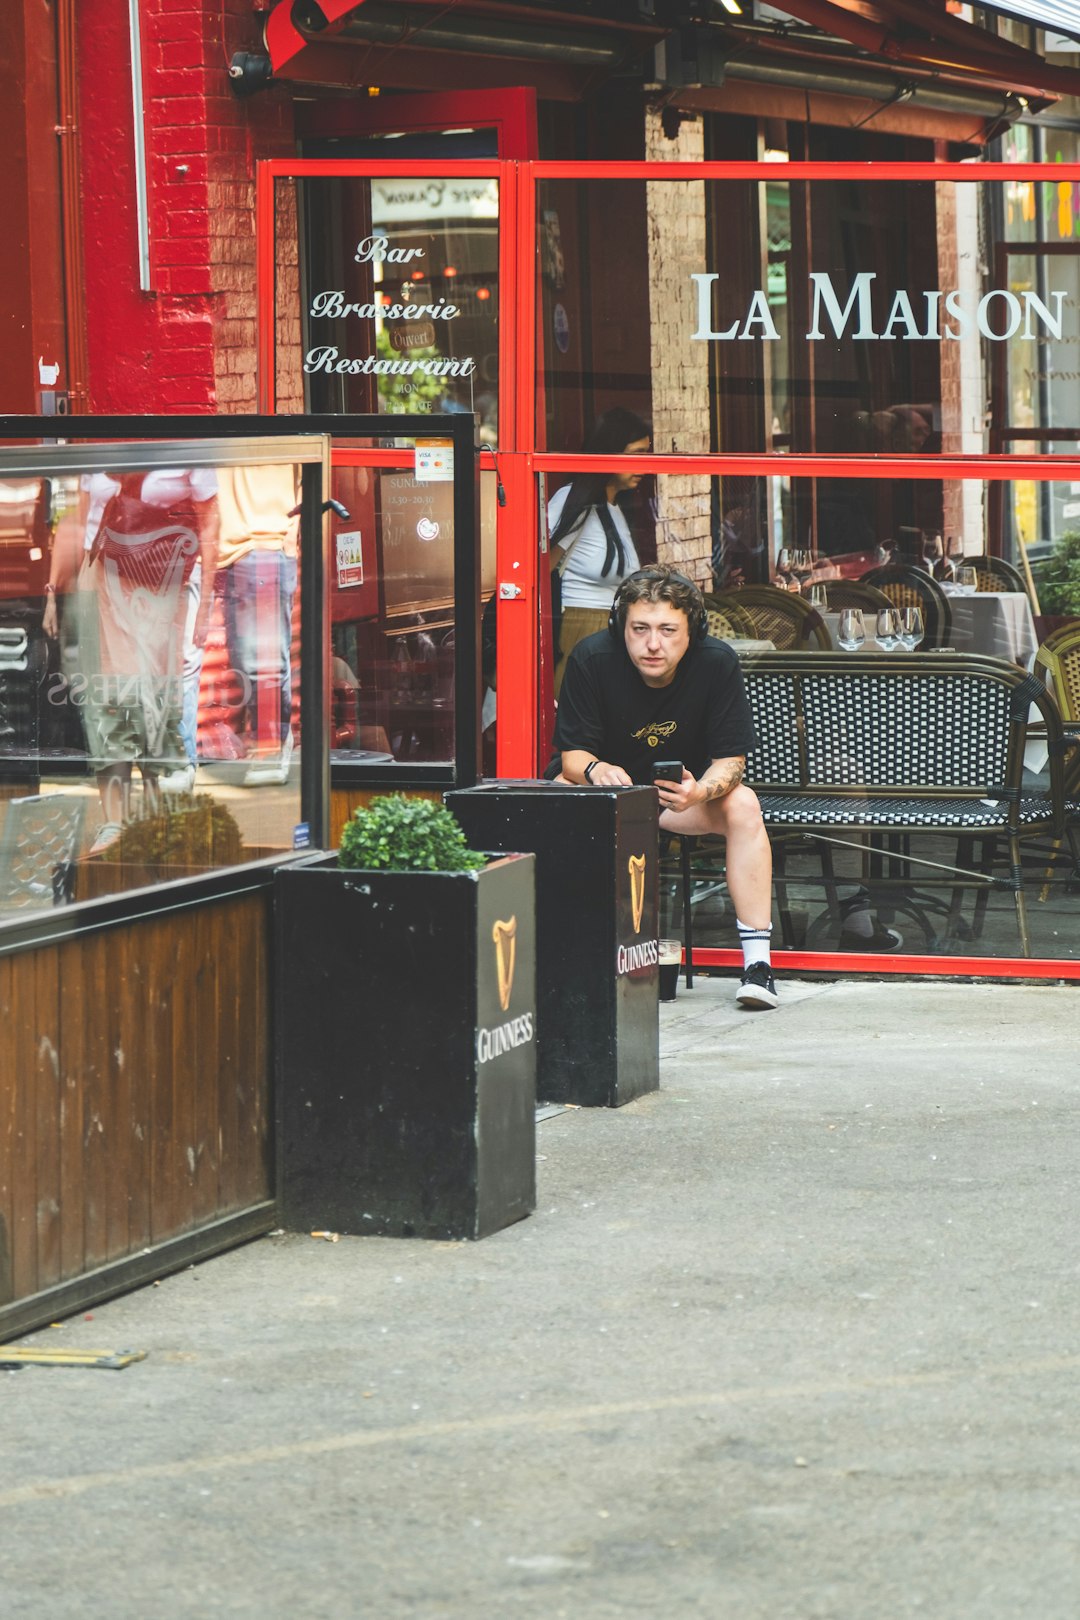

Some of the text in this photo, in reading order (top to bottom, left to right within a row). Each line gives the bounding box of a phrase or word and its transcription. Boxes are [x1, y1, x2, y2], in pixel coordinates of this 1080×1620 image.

[354, 235, 426, 263] Bar
[310, 290, 460, 320] Brasserie
[690, 272, 1068, 341] LA MAISON
[394, 331, 428, 347] Ouvert
[303, 345, 476, 377] Restaurant
[617, 939, 658, 974] GUINNESS
[477, 1012, 533, 1064] GUINNESS
